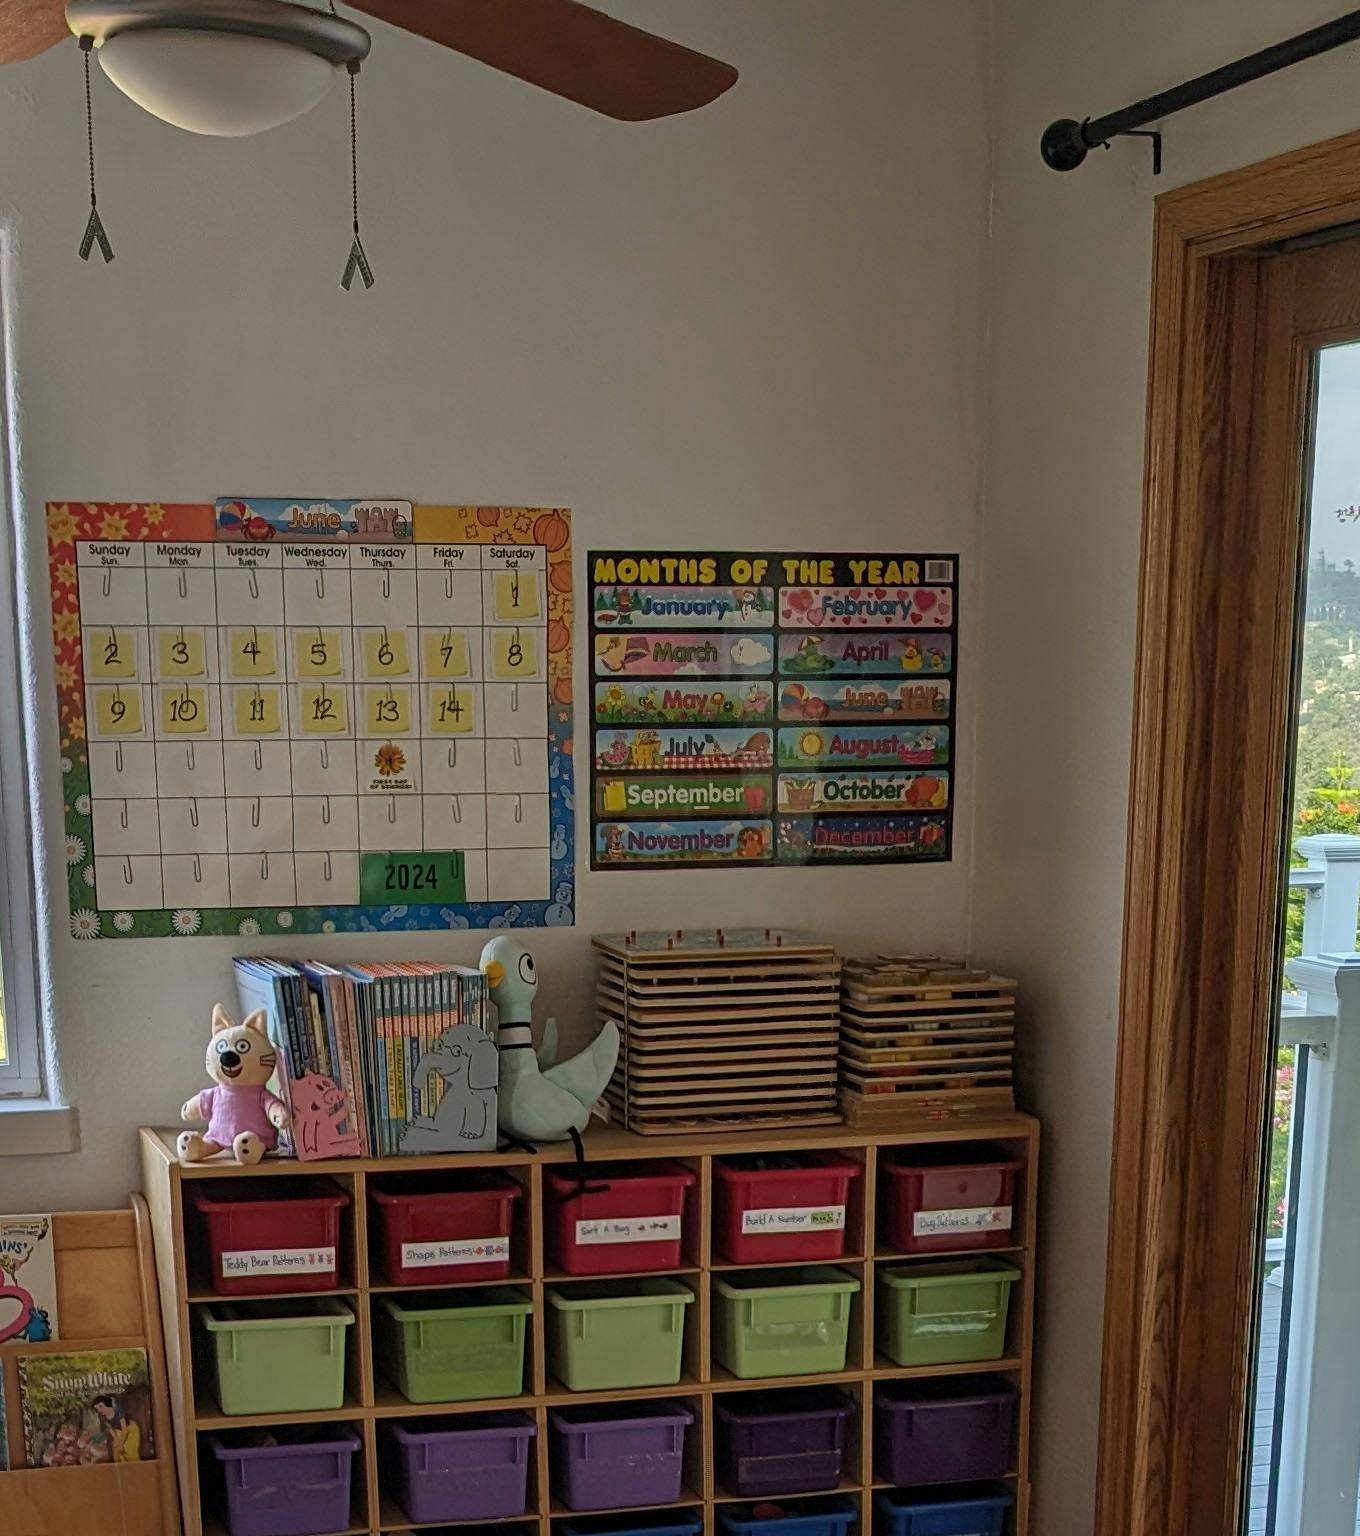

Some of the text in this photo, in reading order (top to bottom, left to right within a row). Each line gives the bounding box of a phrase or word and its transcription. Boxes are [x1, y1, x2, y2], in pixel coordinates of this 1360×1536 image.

[288, 507, 340, 529] June
[88, 543, 130, 557] Sunday
[156, 544, 202, 558] Monday
[226, 545, 270, 559] Tuesday
[284, 545, 347, 559] Wednesday
[360, 546, 406, 560] Thursday
[433, 547, 464, 560] Friday
[490, 548, 535, 561] Saturday
[101, 557, 120, 566] Sun.
[169, 558, 190, 566] Mon.
[238, 558, 259, 567] Tues.
[306, 558, 327, 567] Wed.
[372, 558, 394, 568] Thurs.
[444, 559, 454, 568] Fri.
[506, 560, 520, 568] Sat.
[594, 558, 920, 584] MONTHS OF THE YEAR
[640, 596, 729, 620] January
[821, 596, 912, 620] February
[104, 643, 122, 665] 2
[172, 642, 189, 664] 3
[242, 642, 260, 665] 4
[310, 643, 327, 666] 5
[378, 643, 394, 666] 6
[440, 646, 453, 668] 7
[507, 644, 523, 667] 8
[653, 642, 718, 662] March
[842, 641, 890, 664] April
[312, 696, 336, 720] 12
[662, 689, 708, 714] May
[840, 687, 890, 707] June
[110, 700, 126, 723] 9
[170, 699, 198, 722] 10
[250, 698, 265, 721] 11
[376, 700, 400, 722] 13
[438, 700, 464, 723] 14
[664, 736, 706, 761] July
[829, 734, 898, 759] August
[628, 784, 744, 808] September
[823, 780, 905, 800] October
[628, 829, 735, 852] November
[814, 826, 914, 846] December
[385, 864, 438, 890] 2024
[582, 1226, 599, 1236] Sort
[746, 1216, 766, 1226] Build
[768, 1216, 775, 1224] A
[224, 1256, 248, 1272] Teddy
[251, 1256, 269, 1268] Bear
[406, 1250, 436, 1262] Shape
[42, 1372, 131, 1392] Snow White
